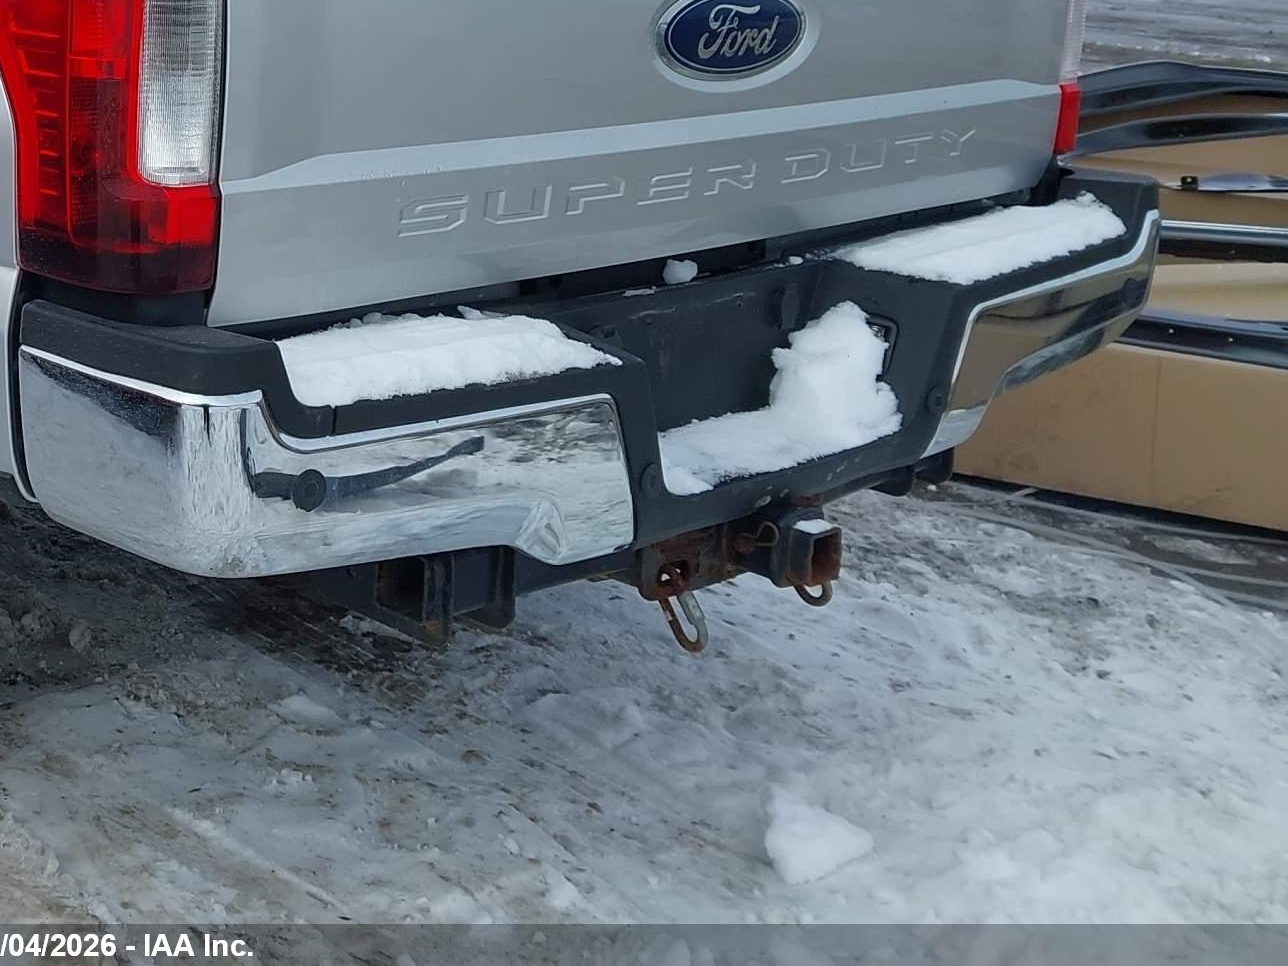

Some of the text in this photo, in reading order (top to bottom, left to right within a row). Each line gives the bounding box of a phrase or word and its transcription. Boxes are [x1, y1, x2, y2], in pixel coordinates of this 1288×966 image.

[697, 3, 780, 59] Ford
[396, 128, 977, 238] SUPER DUTY
